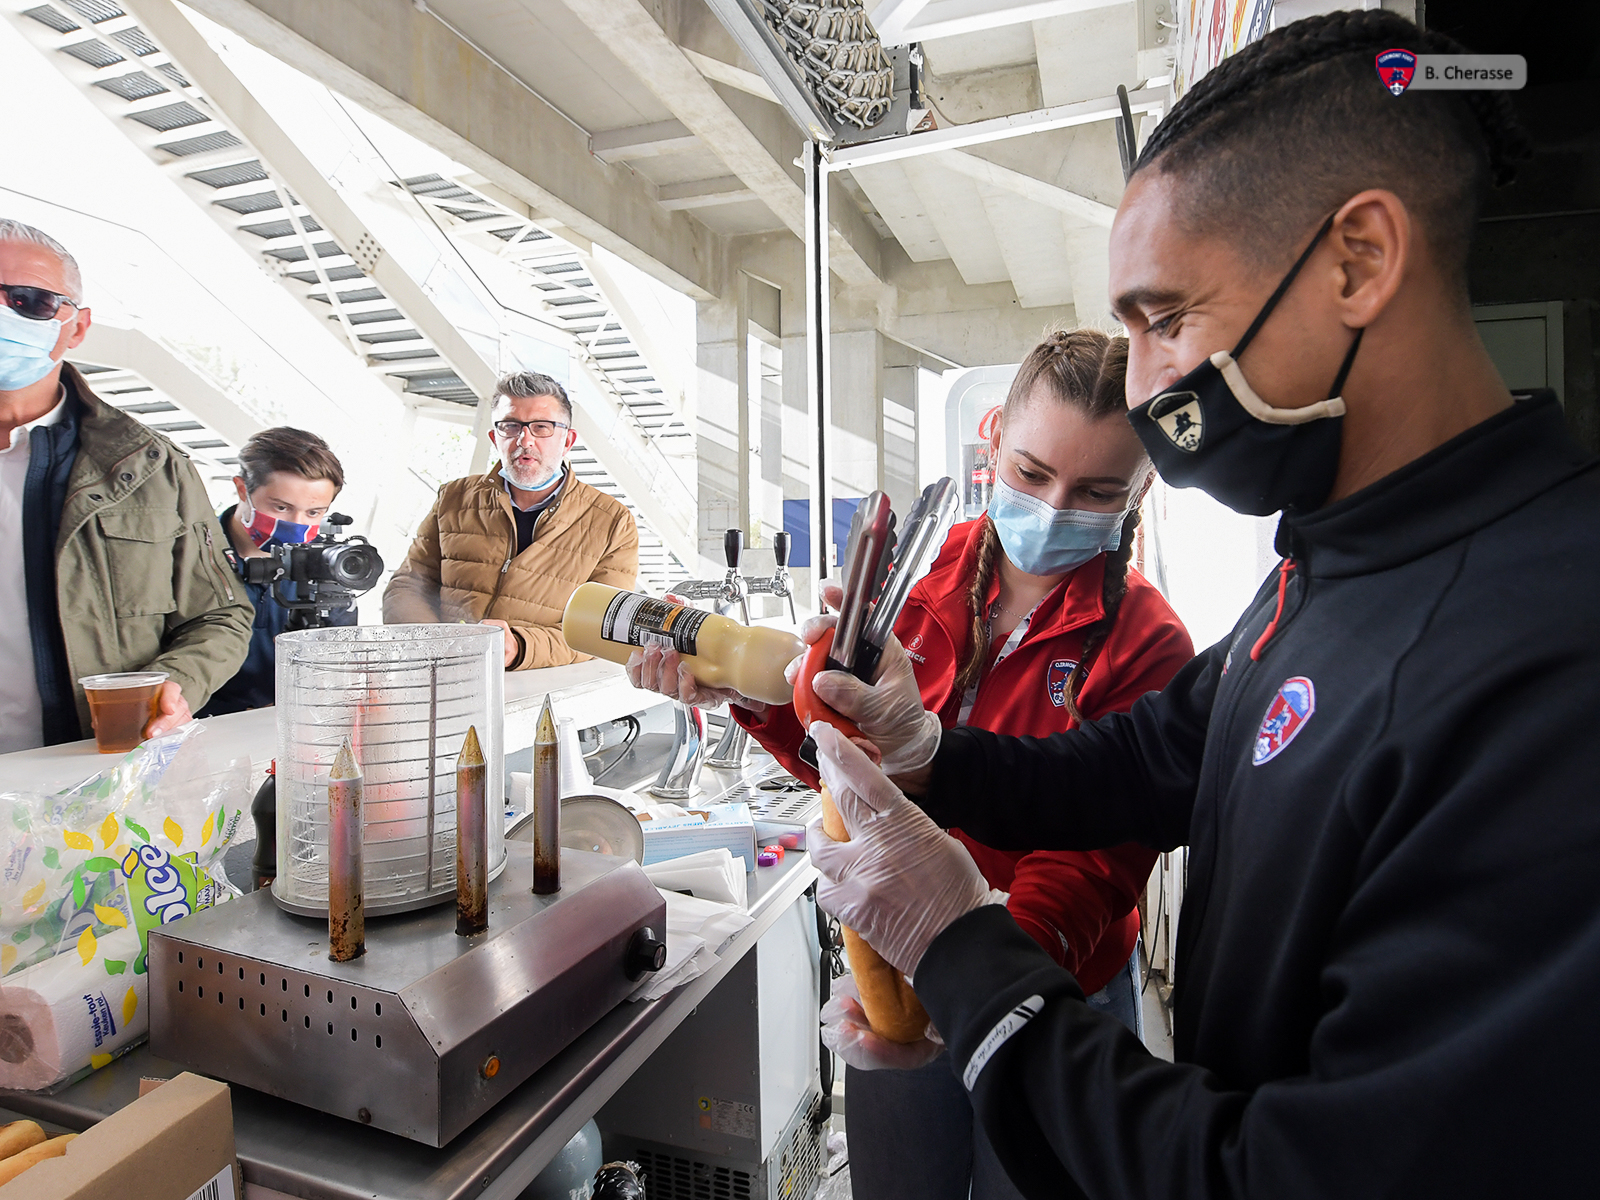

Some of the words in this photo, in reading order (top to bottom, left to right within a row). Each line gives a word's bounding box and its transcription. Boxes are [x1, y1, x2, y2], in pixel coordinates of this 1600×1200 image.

[630, 625, 640, 640] 950g
[1055, 662, 1077, 670] CLERMON
[83, 993, 103, 1048] Essuie-tout
[100, 1007, 109, 1037] Keuken
